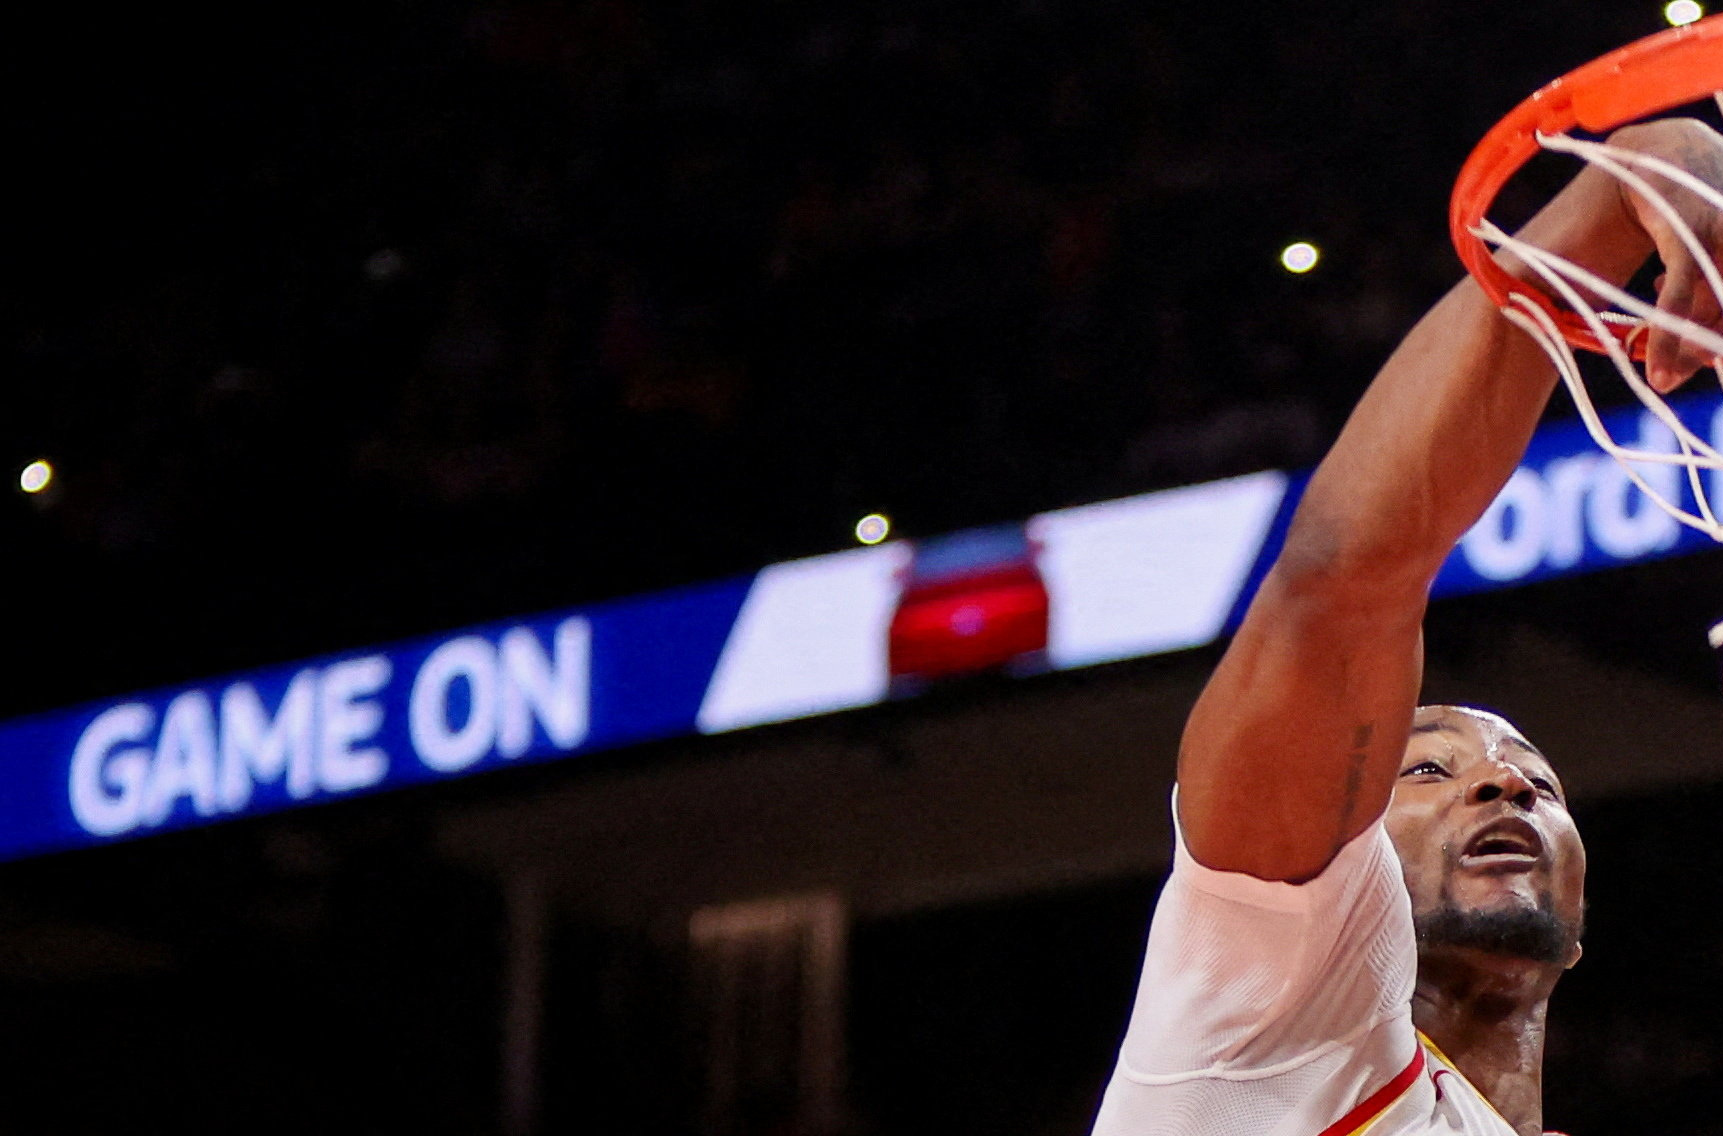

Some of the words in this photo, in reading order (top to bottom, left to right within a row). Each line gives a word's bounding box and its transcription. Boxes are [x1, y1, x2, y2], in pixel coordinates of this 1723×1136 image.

[1458, 402, 1682, 582] ord
[67, 655, 392, 837] GAME
[408, 617, 591, 772] ON
